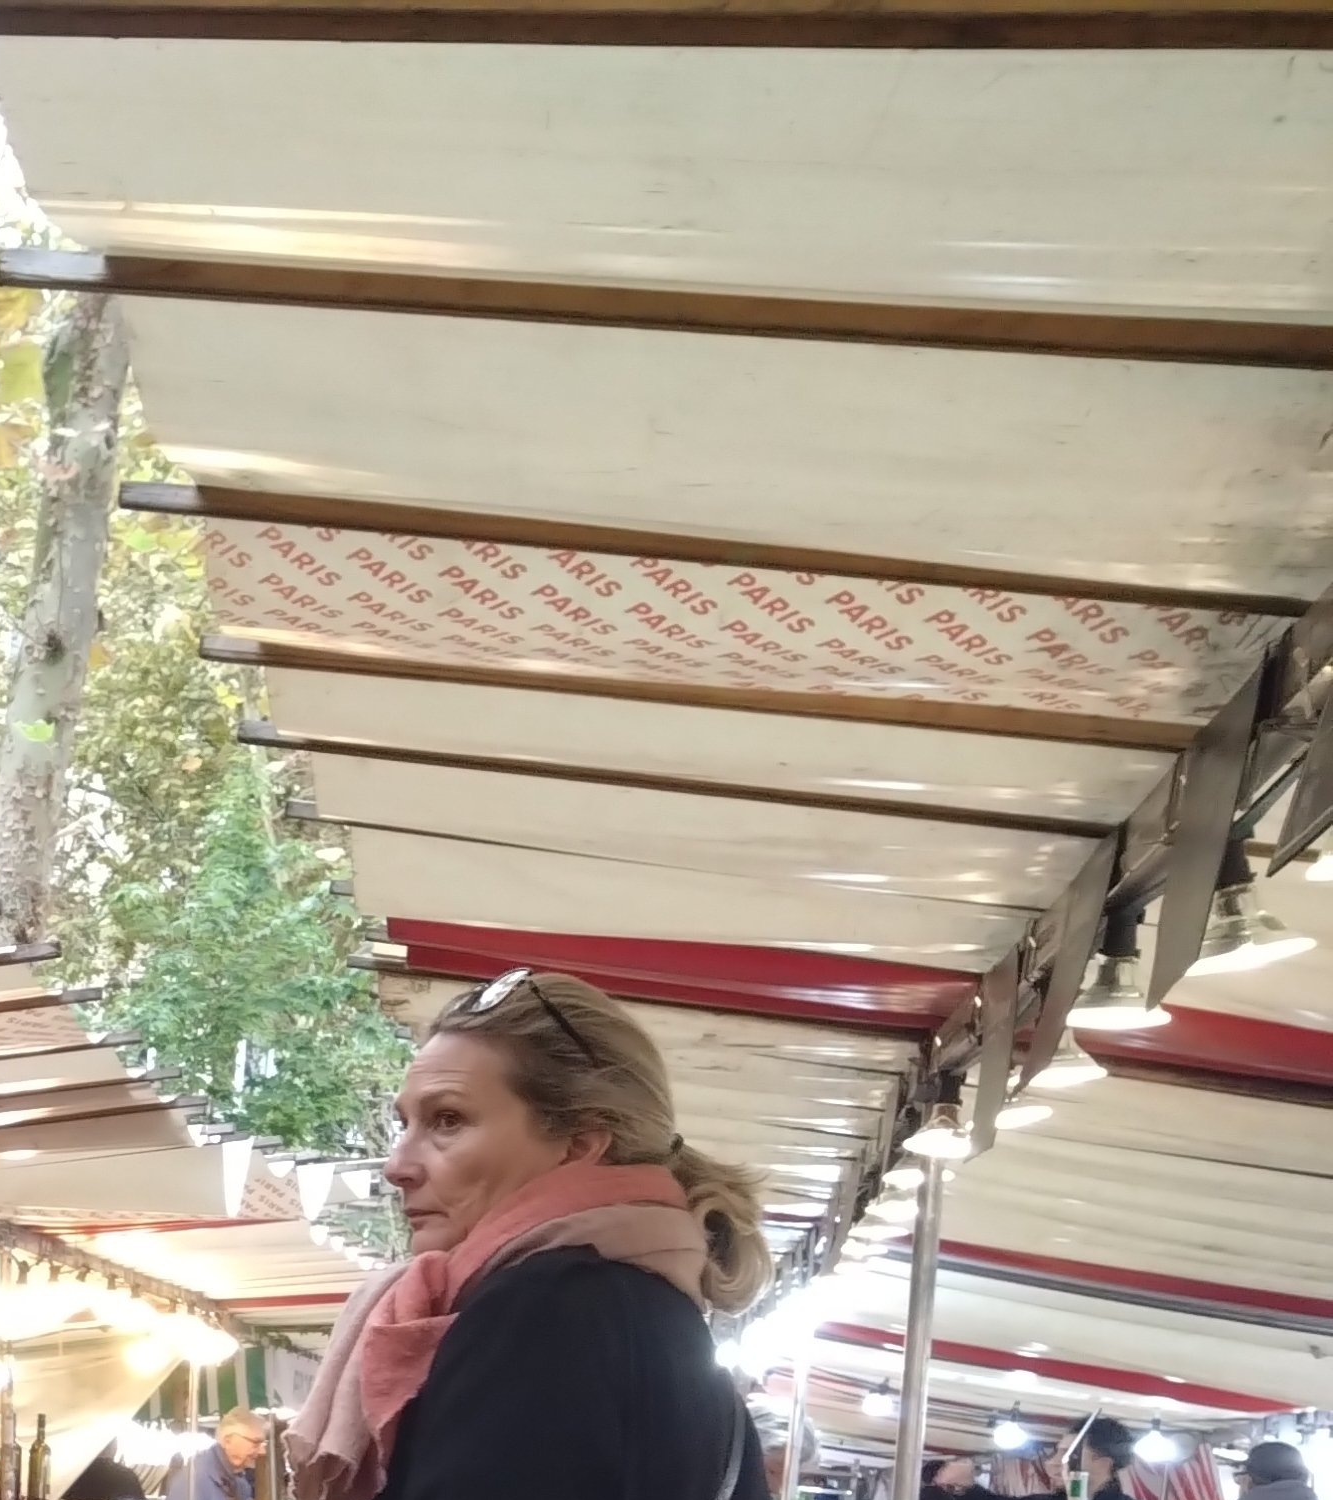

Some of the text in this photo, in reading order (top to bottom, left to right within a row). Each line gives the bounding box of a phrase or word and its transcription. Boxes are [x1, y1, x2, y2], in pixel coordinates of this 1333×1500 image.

[256, 525, 342, 587] PARIS
[346, 547, 434, 604] PARIS
[547, 549, 623, 598] ARIS
[257, 573, 344, 619] PARIS
[438, 565, 525, 619] PARIS
[530, 583, 618, 635] PARIS
[630, 556, 718, 615] PARIS
[727, 572, 815, 634] PARIS
[346, 591, 435, 632] PARIS
[437, 607, 525, 644] PARIS
[624, 602, 717, 648] PARIS
[824, 590, 914, 651] PARIS
[1055, 596, 1131, 645] ARIS
[530, 623, 618, 657] PARIS
[719, 619, 808, 661] PARIS
[815, 638, 906, 675] PARIS
[923, 609, 1014, 667] PARIS
[1025, 628, 1116, 676] PARIS
